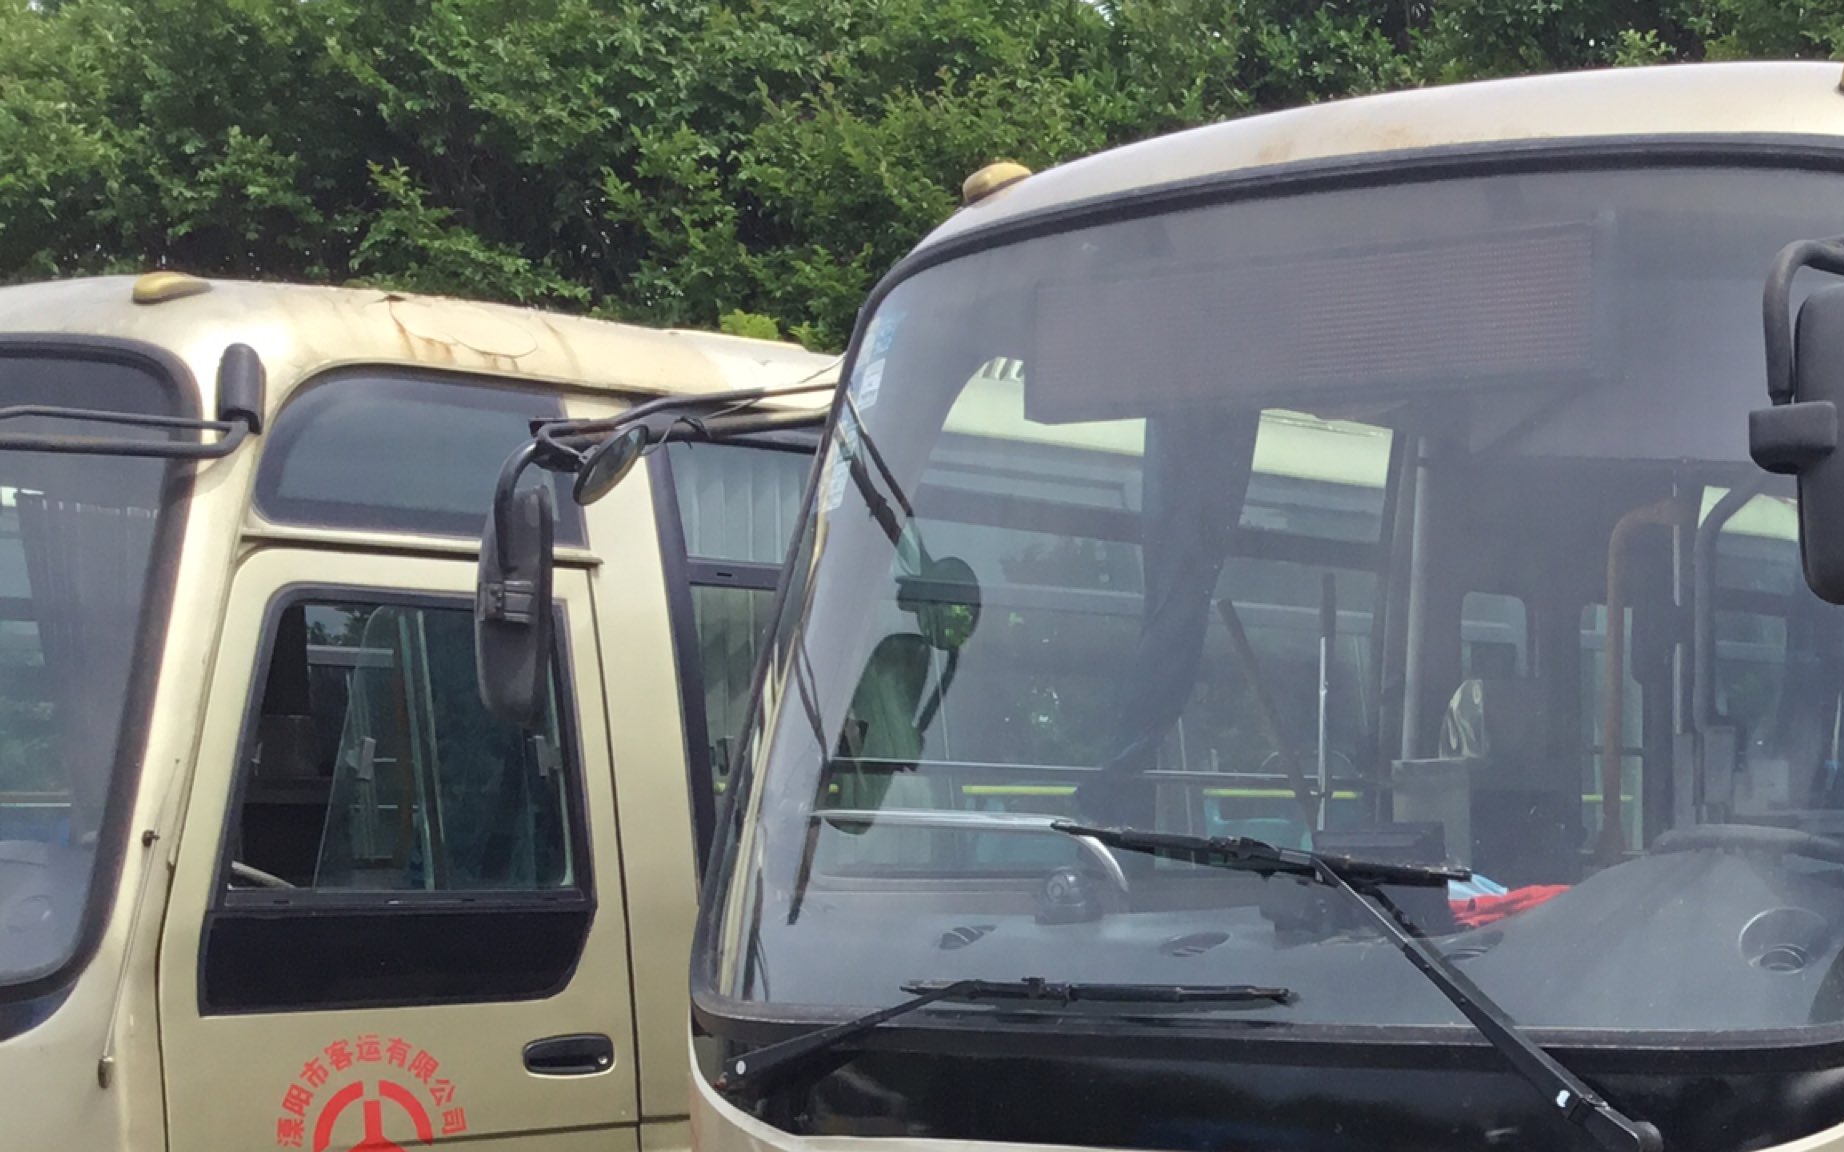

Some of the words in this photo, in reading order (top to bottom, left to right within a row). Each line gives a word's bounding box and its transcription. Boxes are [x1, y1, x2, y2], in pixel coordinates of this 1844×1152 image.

[276, 1034, 468, 1147] 溧阳市客运有限公司
